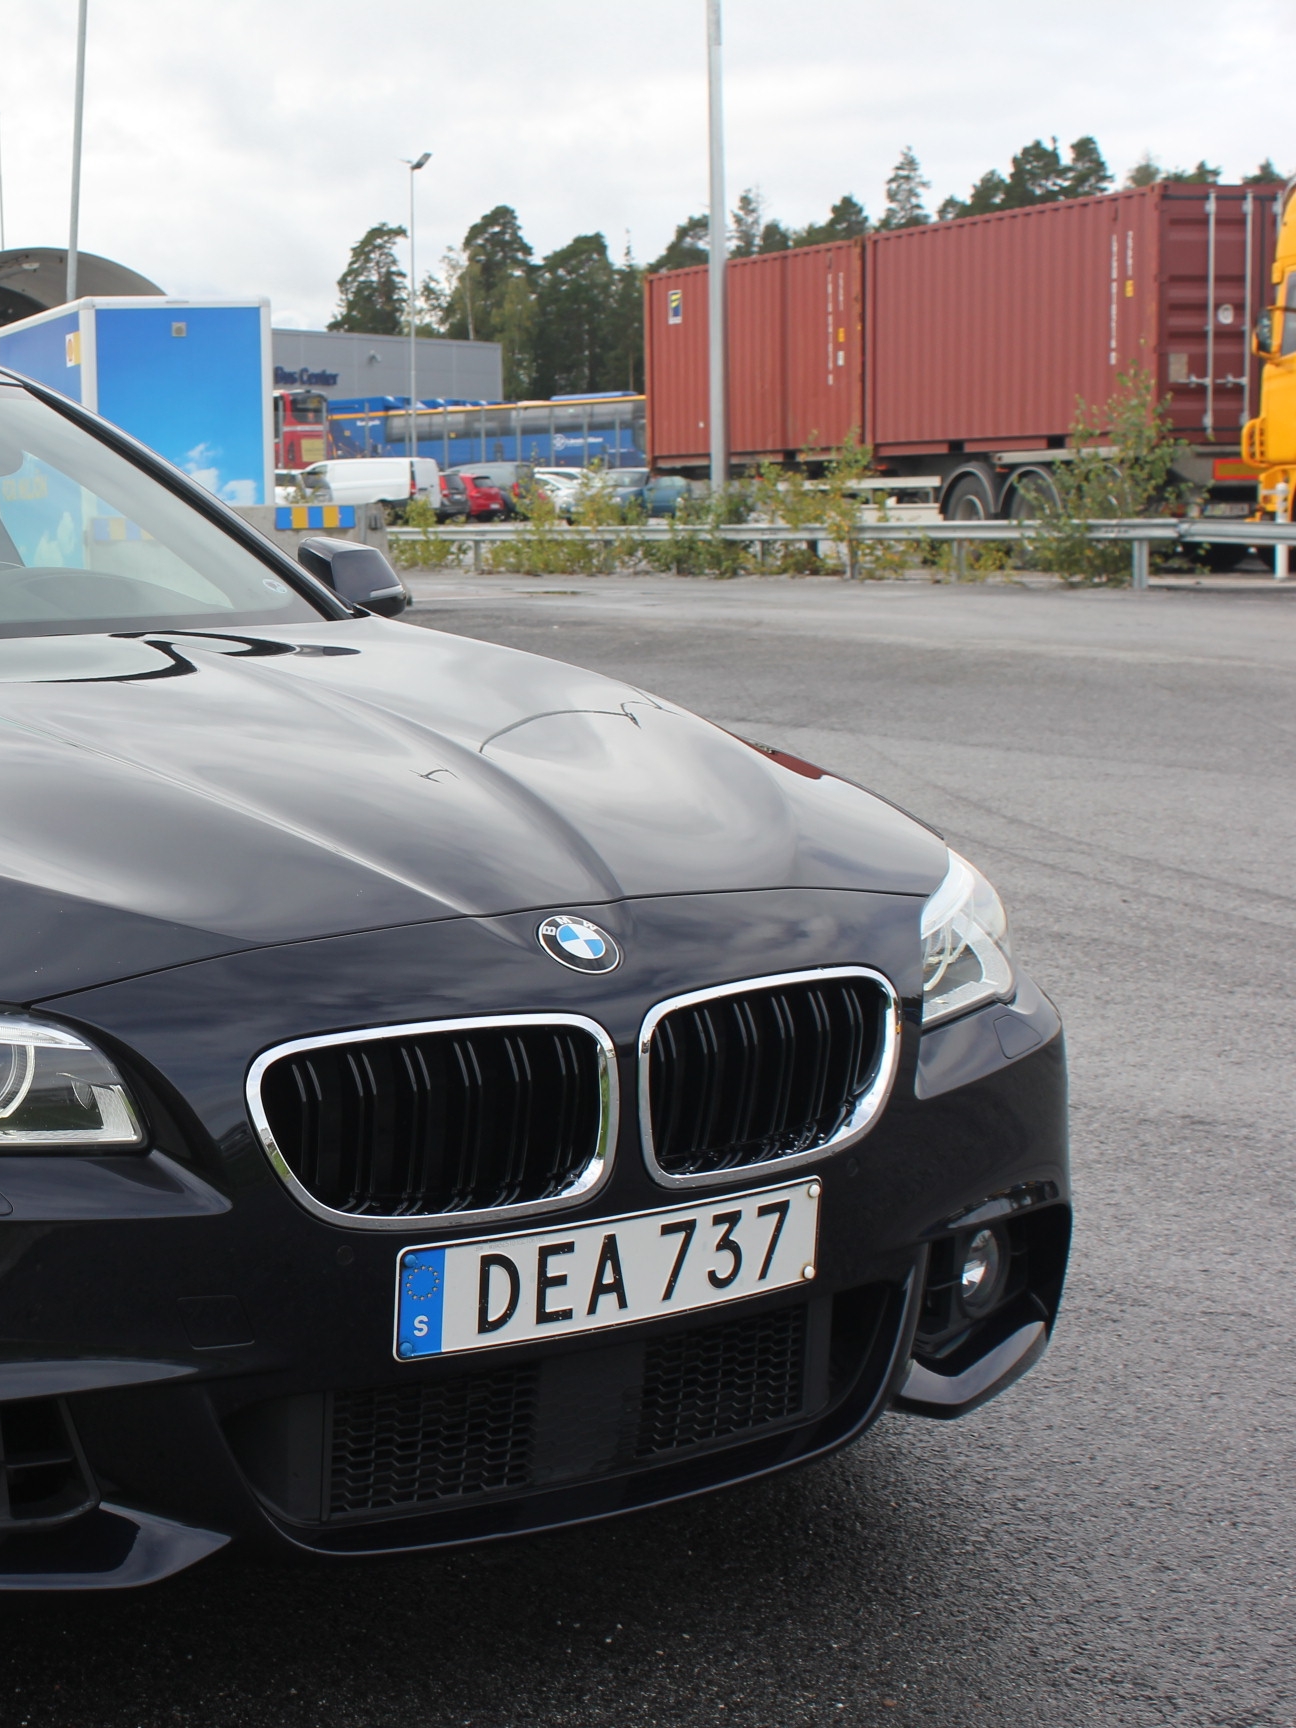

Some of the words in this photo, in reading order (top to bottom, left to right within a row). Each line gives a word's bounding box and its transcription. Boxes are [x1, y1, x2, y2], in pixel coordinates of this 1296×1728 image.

[542, 916, 599, 936] BMW
[477, 1232, 628, 1334] DEA
[660, 1199, 790, 1302] 737
[413, 1315, 429, 1337] S
